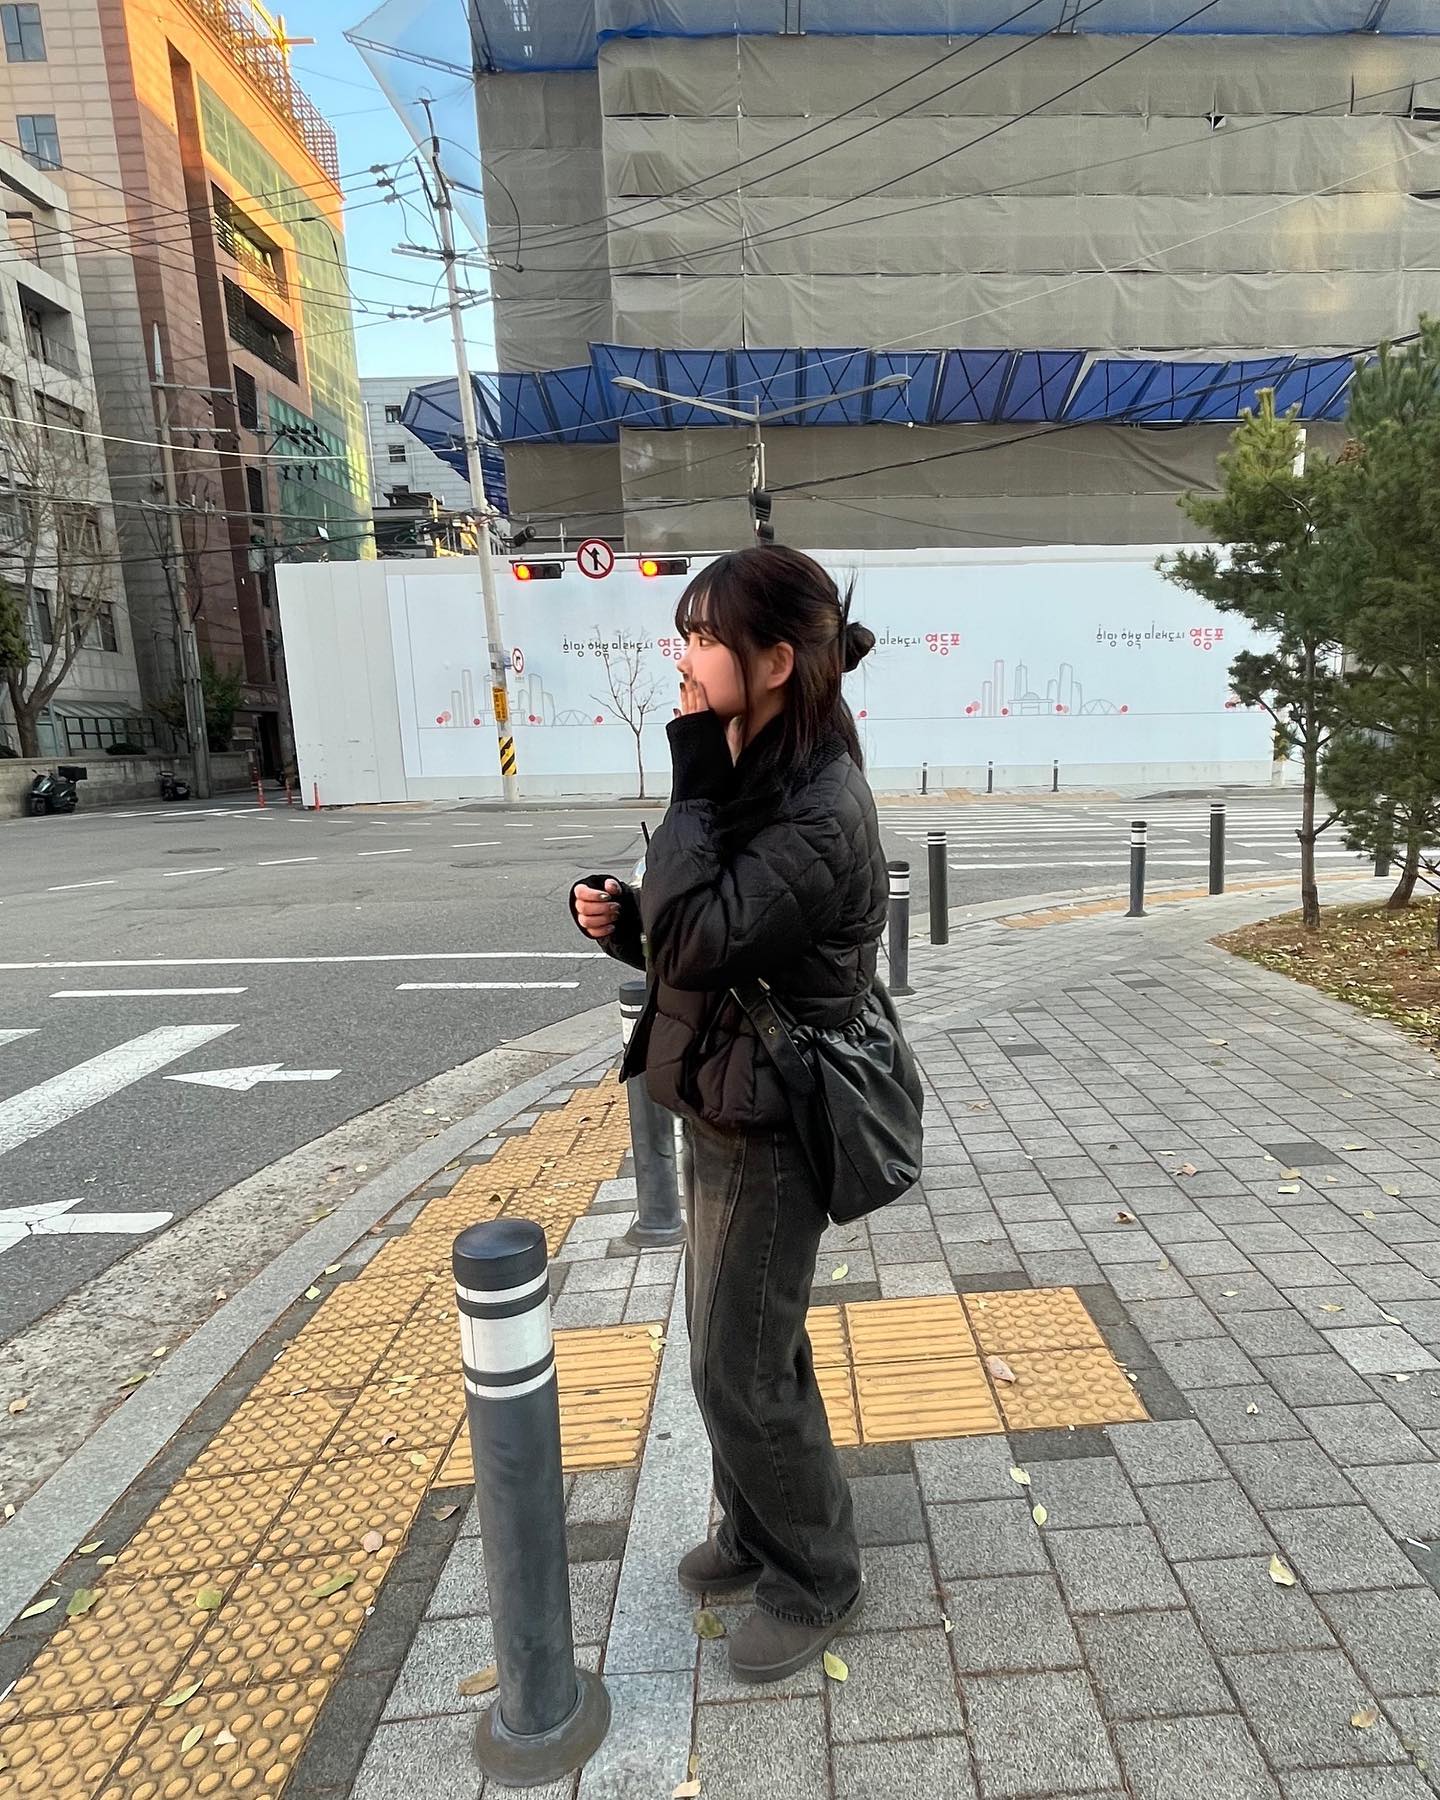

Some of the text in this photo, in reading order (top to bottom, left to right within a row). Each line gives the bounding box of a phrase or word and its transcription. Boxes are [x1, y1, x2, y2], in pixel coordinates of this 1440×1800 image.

[562, 634, 585, 657] 희망
[657, 638, 687, 660] 영등
[879, 626, 960, 656] 미래도시 영등포
[1096, 620, 1224, 651] 희망 행복 미래도시 영등포
